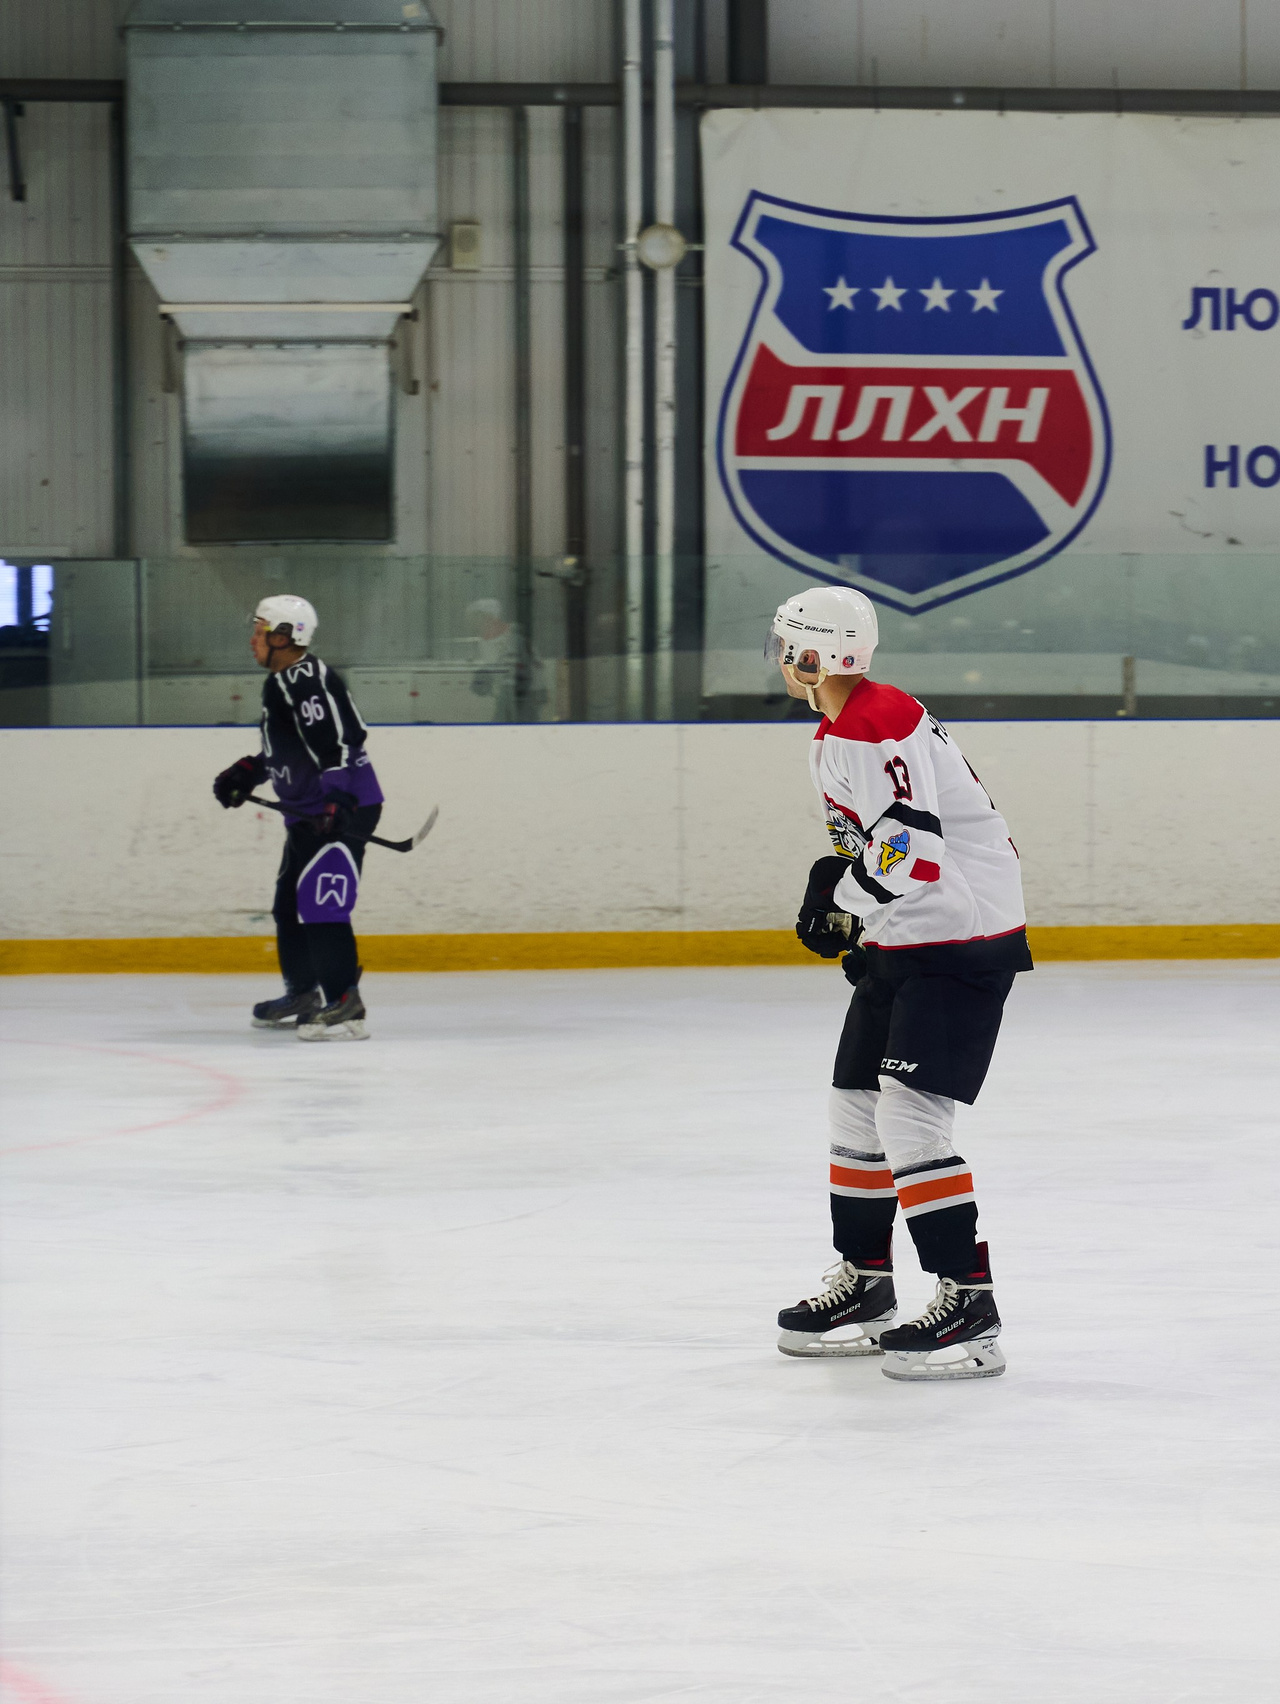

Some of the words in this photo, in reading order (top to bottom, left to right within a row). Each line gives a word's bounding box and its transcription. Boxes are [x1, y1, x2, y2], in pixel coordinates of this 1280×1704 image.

[766, 384, 1050, 443] ЛЛХН
[804, 624, 835, 635] BAUER
[301, 695, 325, 726] 96
[884, 755, 913, 801] 13
[880, 1058, 919, 1073] CCM
[830, 1302, 862, 1323] BAUER
[935, 1317, 966, 1339] BAUER
